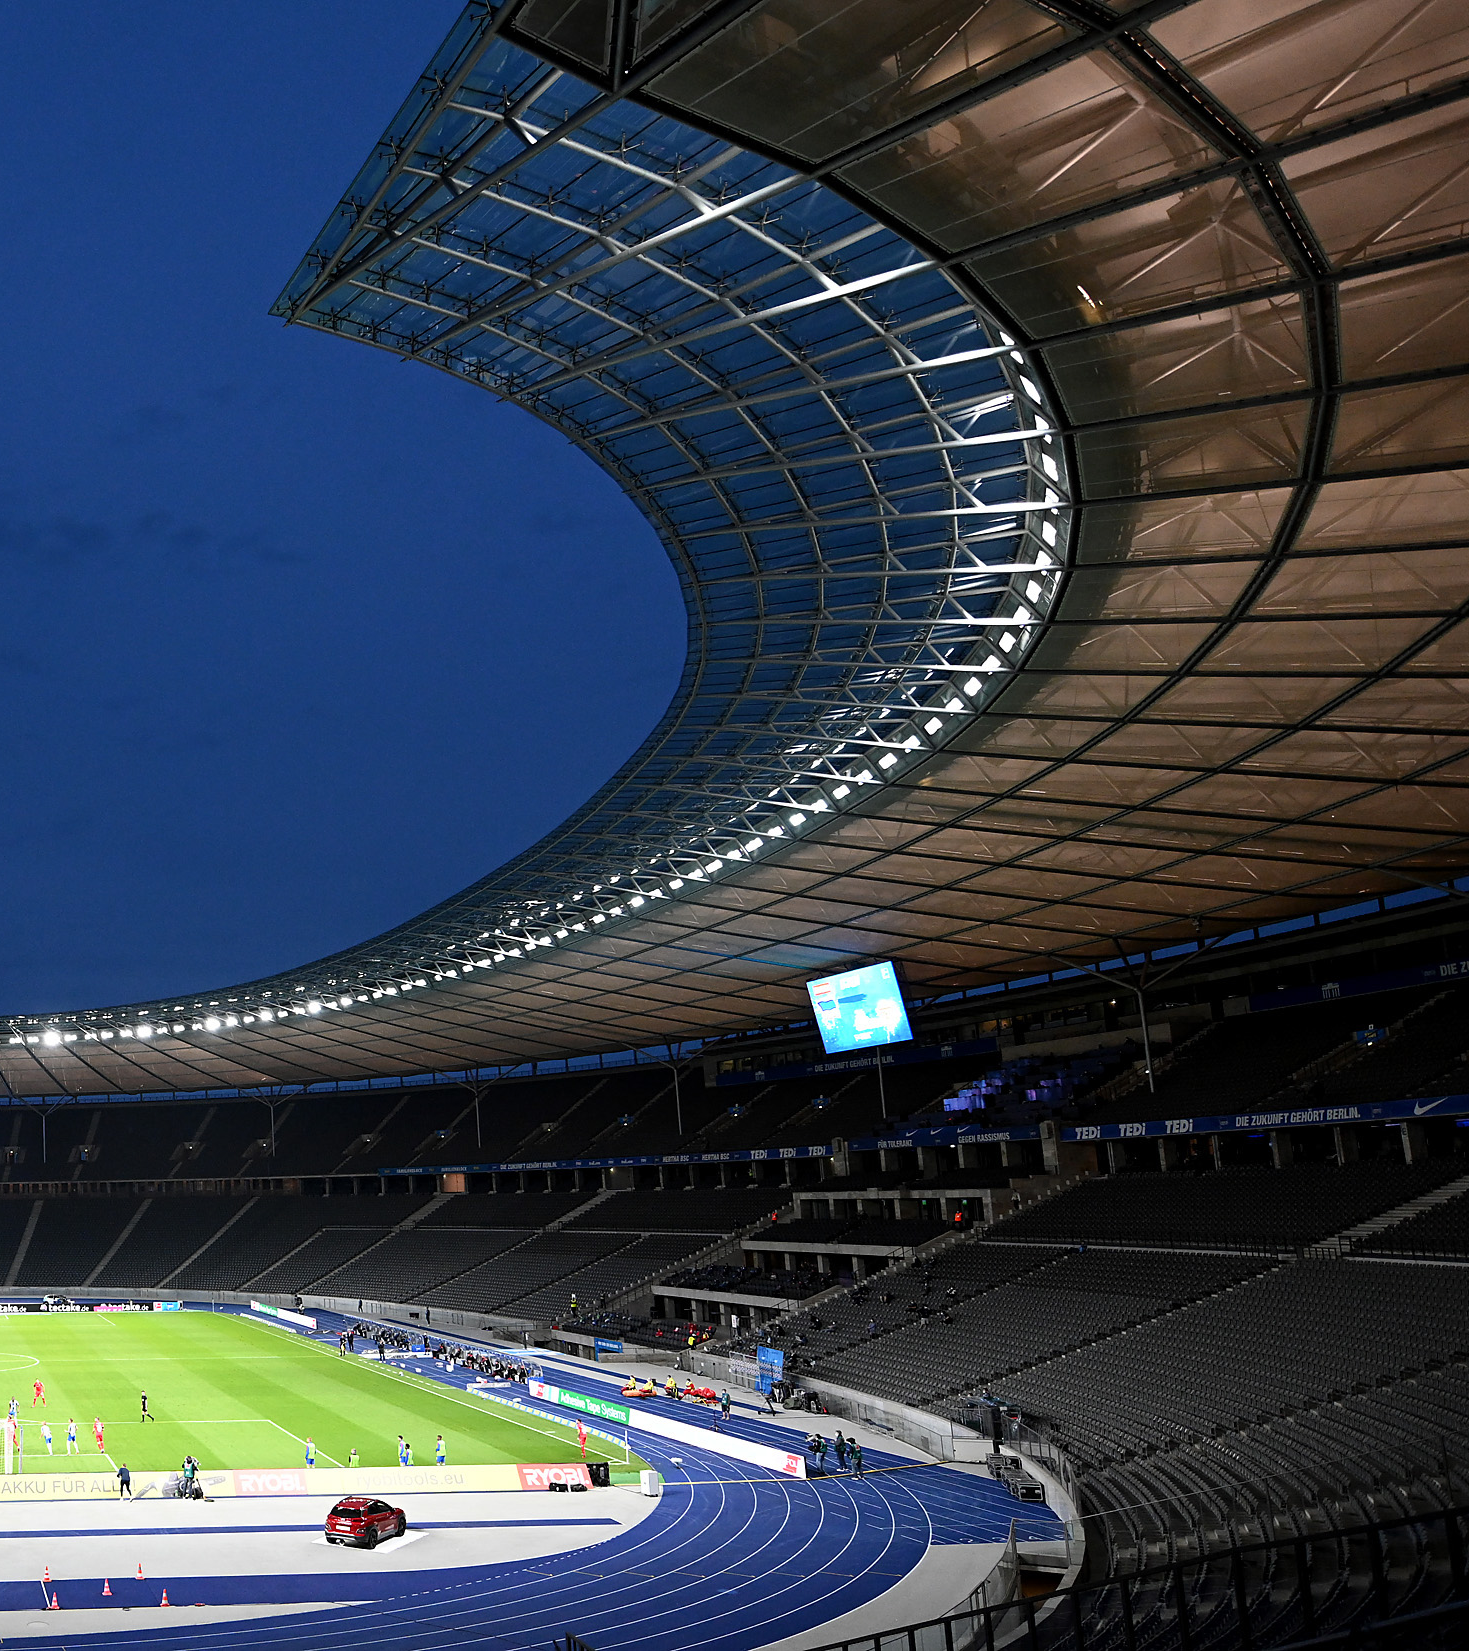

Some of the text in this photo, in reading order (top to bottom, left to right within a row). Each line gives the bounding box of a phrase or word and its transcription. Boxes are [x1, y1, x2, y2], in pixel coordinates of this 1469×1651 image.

[1439, 961, 1469, 977] DIE Z
[1235, 1106, 1361, 1127] DIE ZUKUNFT GEHÖRT BERLIN.
[1075, 1126, 1101, 1140] TEDi
[1118, 1123, 1146, 1137] TEDi
[1165, 1119, 1194, 1134] TEDi
[887, 1139, 913, 1148] TOLERANZ
[957, 1132, 1010, 1144] GEGEN RASSISMUS
[701, 1153, 720, 1161] HERTHA
[750, 1150, 768, 1160] TEDi
[779, 1147, 796, 1158] TEDi
[808, 1146, 826, 1156] TEDi
[48, 1302, 90, 1312] tectake.de
[561, 1391, 627, 1422] Adhesive Tape Systems
[1, 1480, 46, 1494] AKKU
[52, 1477, 85, 1493] FÜR
[356, 1473, 465, 1490] ryobitools.eu
